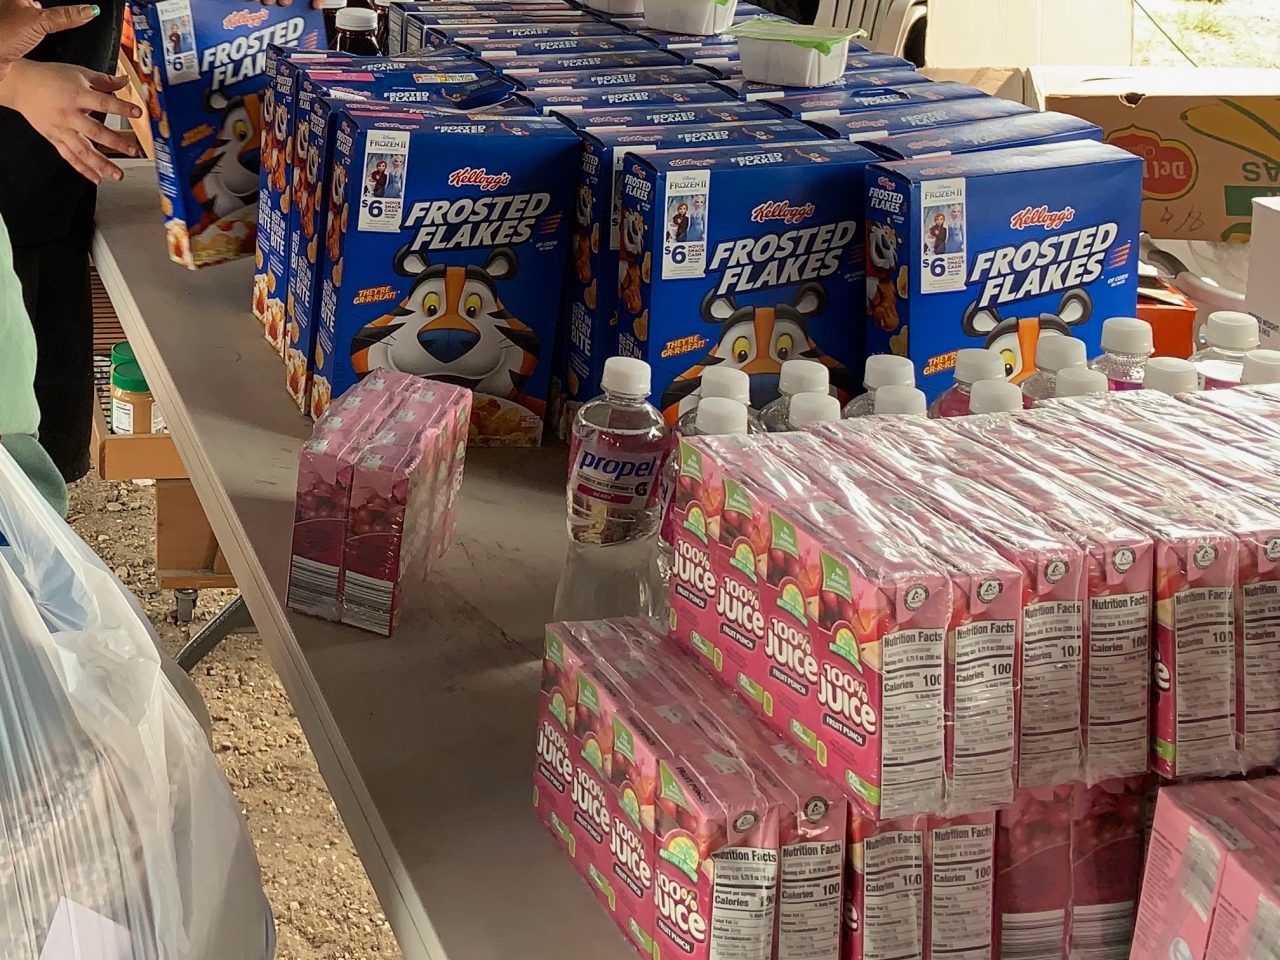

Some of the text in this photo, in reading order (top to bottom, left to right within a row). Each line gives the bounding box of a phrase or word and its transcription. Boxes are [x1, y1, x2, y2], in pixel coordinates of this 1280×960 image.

[201, 17, 305, 72] FROSTED
[213, 40, 298, 90] FLA
[601, 92, 650, 100] FROSTED
[646, 111, 696, 120] FROSTED
[370, 139, 407, 149] FROZEN II
[677, 131, 729, 140] FROSTED
[685, 135, 729, 143] FLAKES
[730, 153, 783, 163] FROSTED
[739, 157, 783, 167] FLAKES
[448, 167, 511, 190] Kellogg's
[1154, 161, 1187, 179] Del
[625, 174, 652, 191] FROSTED
[669, 180, 707, 189] FROZEN II
[625, 184, 649, 201] FLAKES
[869, 187, 904, 204] FROSTED
[924, 189, 962, 200] FROZEN II
[361, 199, 384, 218] $6
[404, 193, 551, 227] FROSTED
[751, 200, 816, 224] Kellogg's
[871, 198, 901, 214] FLAKES
[1010, 205, 1075, 230] Kellogg's
[271, 221, 285, 240] EVERY
[410, 218, 535, 251] FLAKES
[270, 232, 285, 256] BITE
[708, 220, 857, 270] FROSTED
[969, 222, 1118, 282] FROSTED
[664, 244, 686, 264] $6
[717, 248, 842, 295] FLAKES
[922, 256, 946, 278] $6
[297, 267, 311, 290] EVERY
[978, 252, 1105, 308] FLAKES
[296, 281, 310, 308] BITE
[358, 285, 393, 297] THEY'RE
[321, 306, 335, 333] BITE
[572, 315, 592, 337] EVERY
[571, 328, 591, 357] BITE
[666, 334, 701, 350] THEY'RE
[923, 359, 957, 375] GR-R-RE
[927, 352, 957, 366] THEY'R
[580, 450, 657, 481] propel
[678, 540, 710, 570] 100%
[677, 586, 705, 608] FRUIT PUNCH
[724, 577, 759, 609] 100%
[1176, 592, 1206, 605] Nutrition
[1245, 586, 1277, 597] Nutrition
[1024, 603, 1081, 618] Nutrition Facts
[1091, 595, 1149, 610] Nutrition Facts
[723, 626, 753, 649] FRUIT PUNCH
[771, 618, 811, 654] 100%
[884, 631, 943, 648] Nutrition Facts
[957, 625, 988, 639] Nutrition
[990, 622, 1014, 634] Facts
[1246, 630, 1276, 640] Calories
[1091, 636, 1147, 653] Calories 100
[773, 668, 806, 695] FRUIT PUNCH
[957, 663, 1011, 683] Calories 100
[824, 664, 868, 703] 100%
[884, 674, 941, 692] Calories 100
[544, 721, 569, 756] 100%
[826, 716, 863, 745] FRUIT PUNCH
[577, 768, 606, 805] 100%
[615, 818, 645, 858] 100%
[898, 833, 921, 844] Facts
[934, 826, 992, 841] Nutrition Facts
[752, 851, 777, 863] Facts
[783, 843, 841, 857] Nutrition Facts
[616, 865, 642, 897] FRUIT PUNCH
[934, 867, 991, 883] Calories 100
[656, 869, 698, 910] 100%
[782, 883, 840, 900] Calories 100
[715, 896, 749, 907] Calories
[659, 920, 690, 952] FRUIT PUNCH
